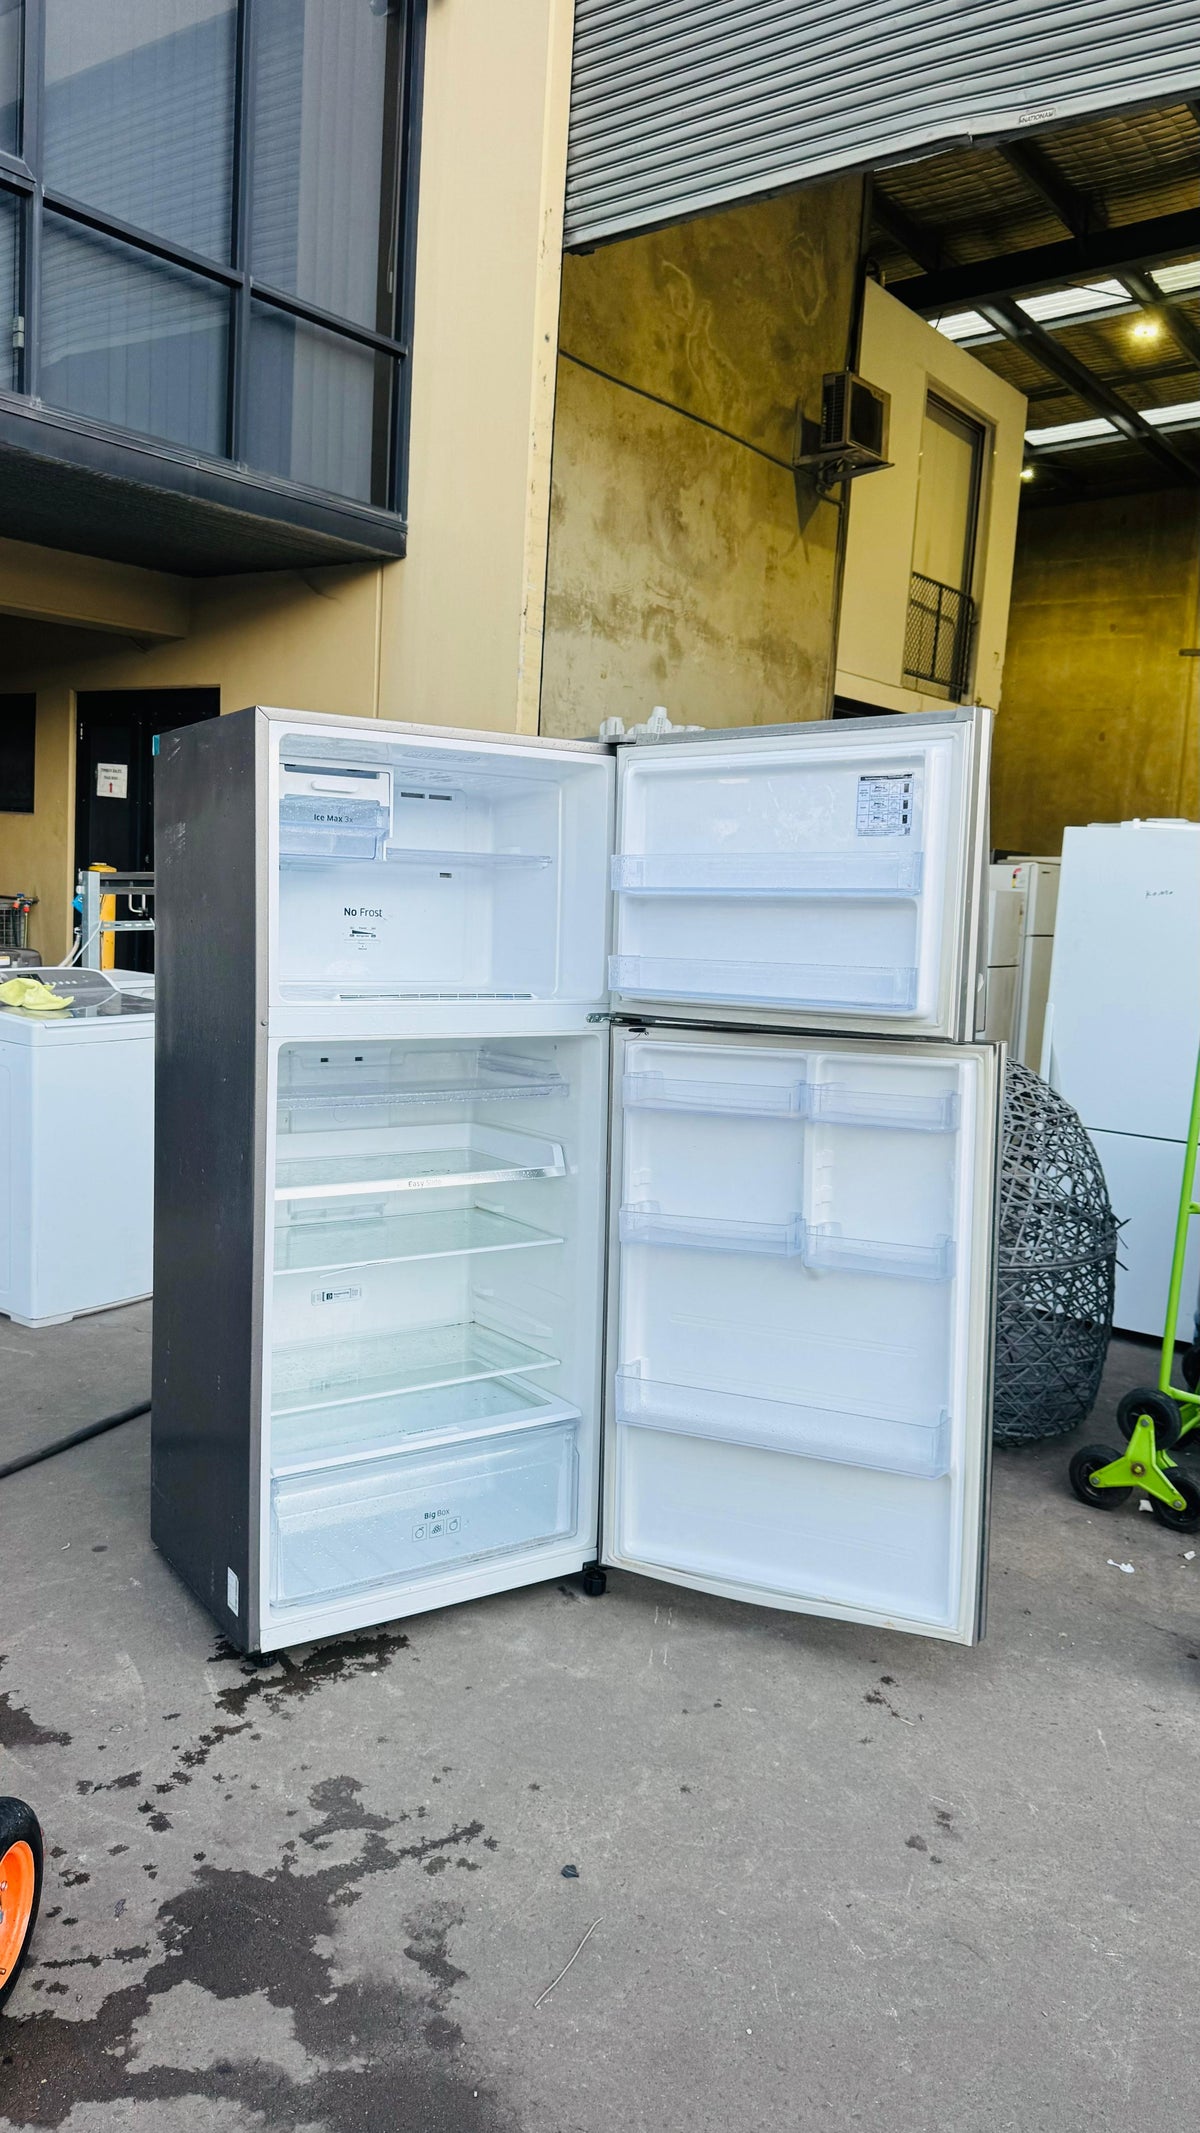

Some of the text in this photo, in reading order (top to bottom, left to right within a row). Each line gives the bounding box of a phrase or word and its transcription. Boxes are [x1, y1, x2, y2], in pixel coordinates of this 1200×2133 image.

[327, 815, 343, 823] Max
[344, 907, 382, 918] No Frost
[408, 1180, 424, 1188] Easy
[424, 1509, 450, 1520] Big Box
